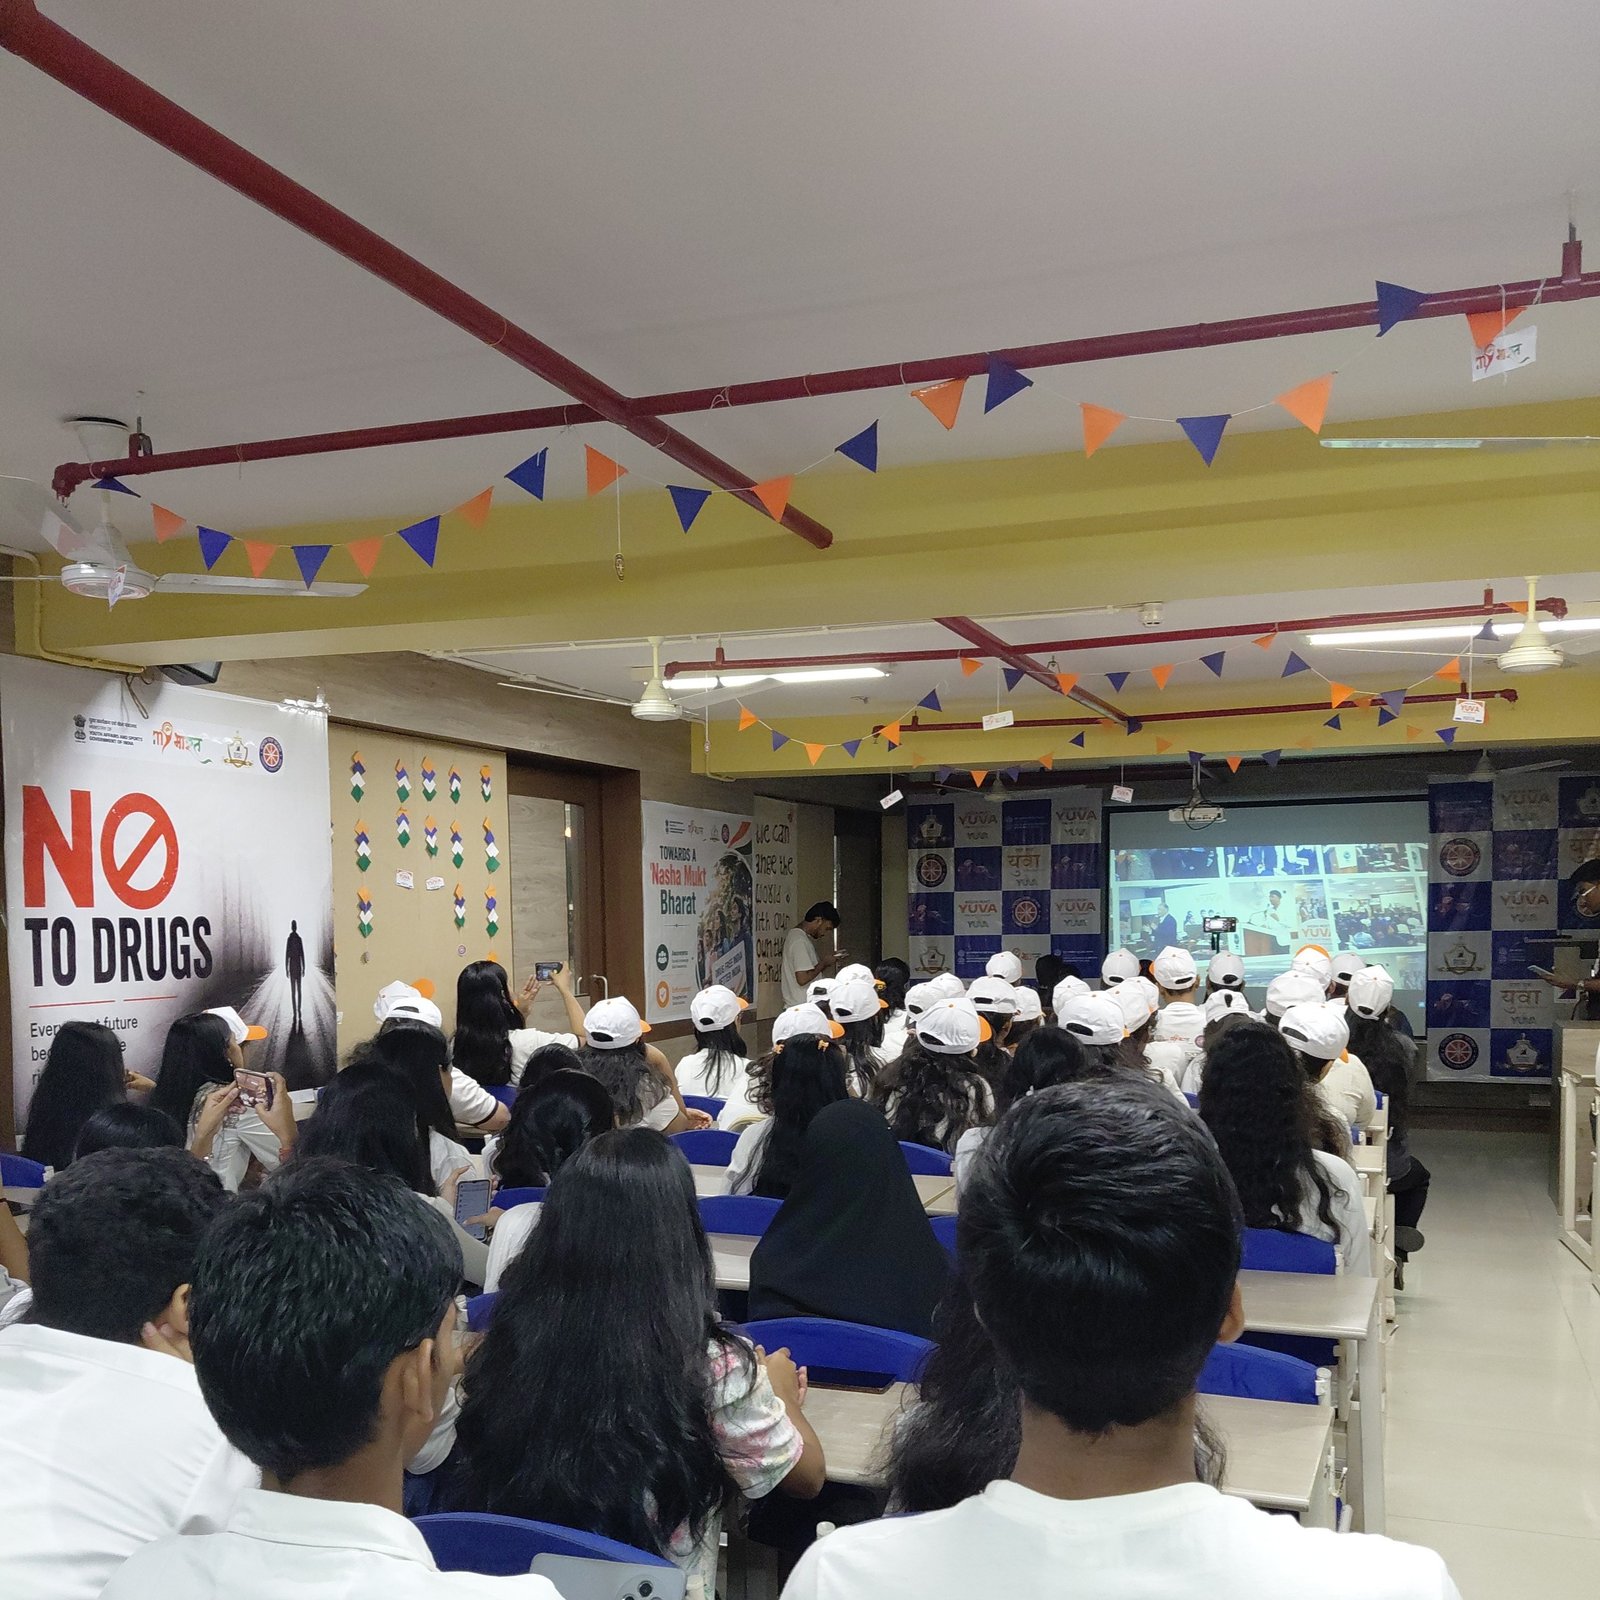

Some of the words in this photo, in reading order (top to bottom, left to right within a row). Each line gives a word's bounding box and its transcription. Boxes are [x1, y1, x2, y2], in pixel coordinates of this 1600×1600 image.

[959, 814, 998, 825] YUVA
[1055, 810, 1097, 821] YUVA
[773, 824, 789, 844] can
[22, 784, 179, 910] NO
[660, 845, 691, 861] TOWARDS
[692, 848, 697, 862] A
[756, 853, 777, 875] ange
[780, 855, 793, 875] the
[684, 864, 707, 887] Mukt
[660, 889, 696, 915] Bharat
[958, 903, 997, 914] YUVA
[1055, 901, 1096, 912] YUVA
[1500, 894, 1549, 906] YUVA
[756, 912, 770, 931] ith
[24, 916, 77, 987] TO
[92, 915, 213, 984] DRUGS
[1500, 990, 1542, 1014] युवा
[104, 1016, 138, 1031] future
